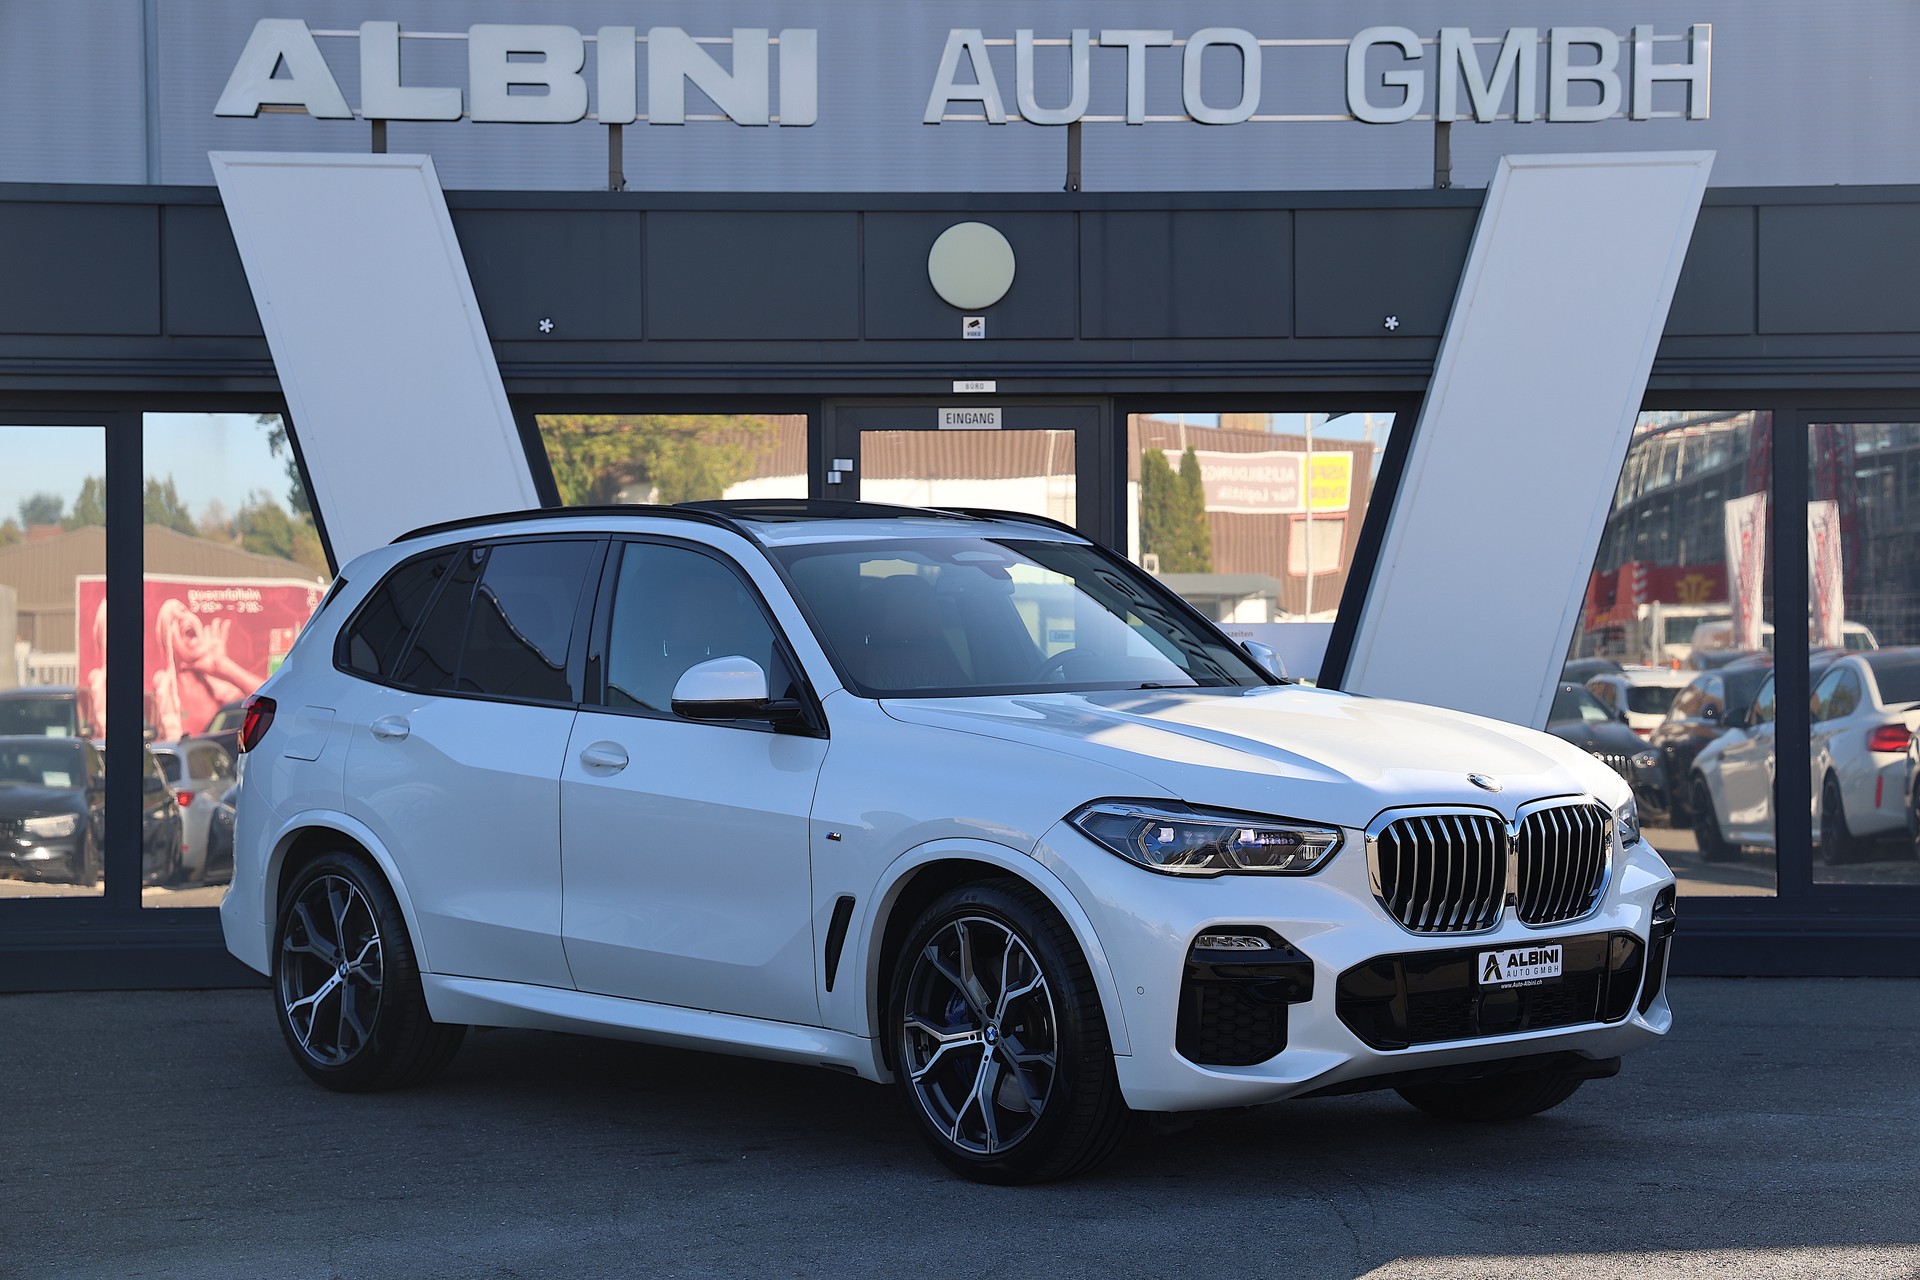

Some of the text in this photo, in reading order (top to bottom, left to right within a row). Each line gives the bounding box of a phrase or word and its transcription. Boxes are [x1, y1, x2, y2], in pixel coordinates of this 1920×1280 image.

[213, 18, 1712, 126] ALBINI AUTO GMBH
[946, 412, 994, 424] EINGANG
[1507, 949, 1558, 968] ALBINI
[1507, 966, 1558, 977] AUTO GMBH
